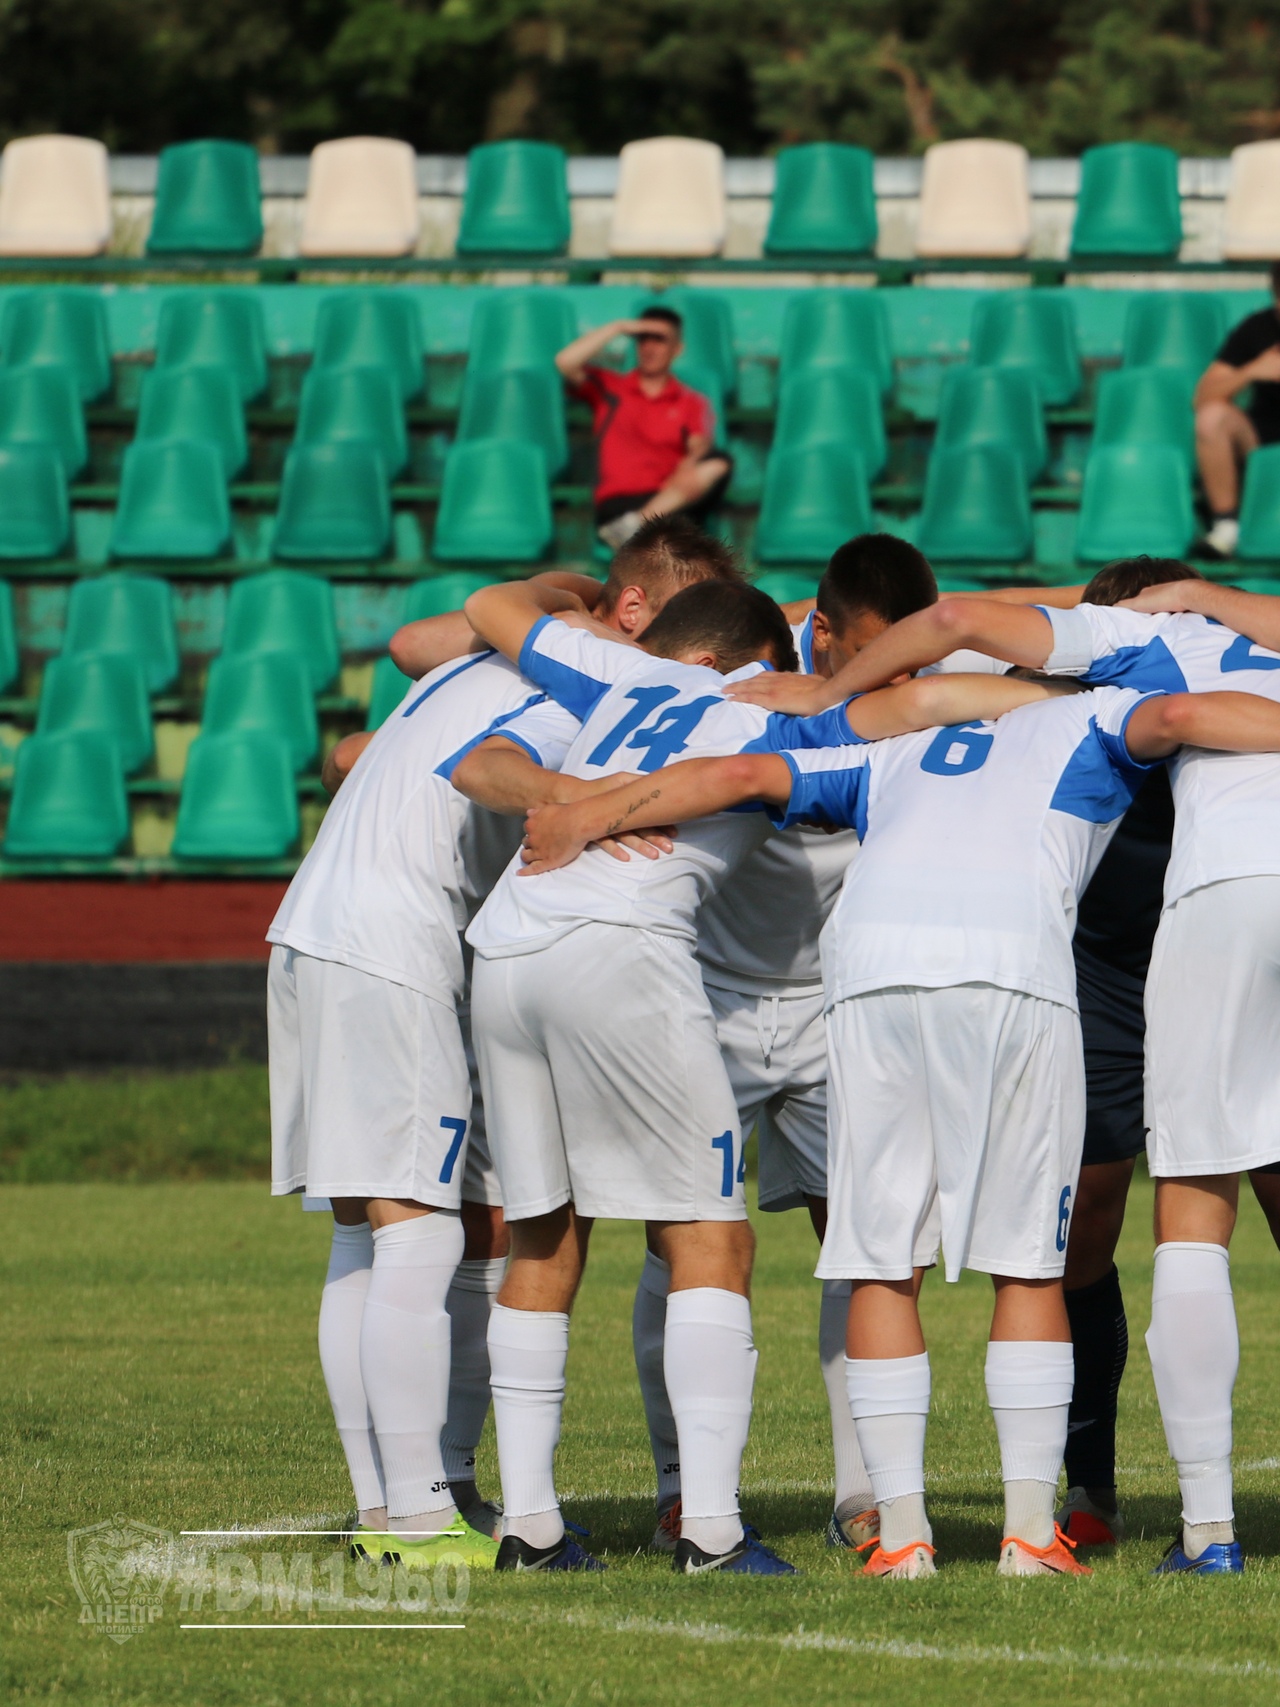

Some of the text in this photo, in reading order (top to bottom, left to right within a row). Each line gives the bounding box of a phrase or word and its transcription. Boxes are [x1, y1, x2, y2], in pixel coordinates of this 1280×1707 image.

[586, 685, 725, 773] 14
[920, 720, 994, 776] 6
[439, 1116, 467, 1184] 7
[1055, 1185, 1071, 1252] 6
